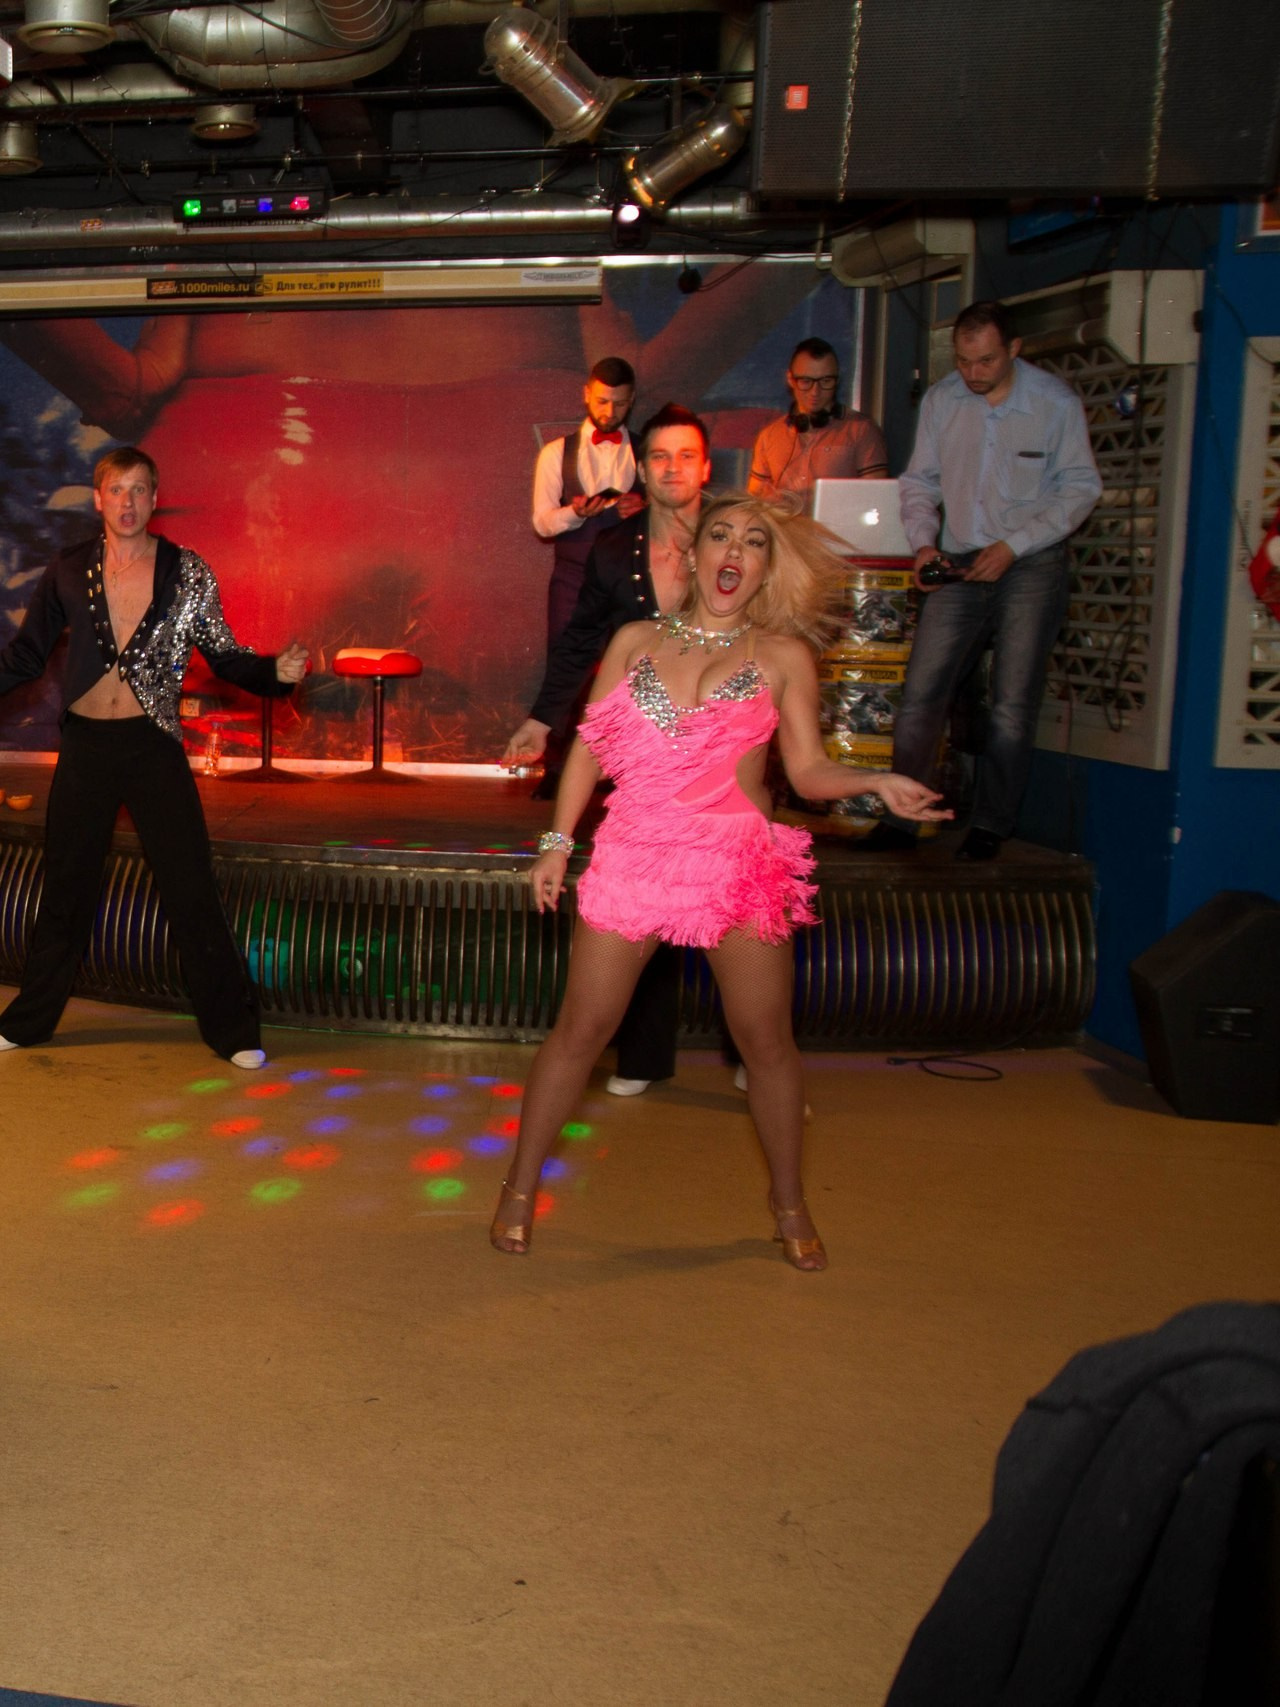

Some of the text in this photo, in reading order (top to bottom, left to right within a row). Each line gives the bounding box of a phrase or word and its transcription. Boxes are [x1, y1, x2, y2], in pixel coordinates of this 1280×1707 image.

[152, 281, 250, 294] .1000miles.ru
[276, 281, 296, 291] Для
[338, 278, 381, 292] рулит!!!
